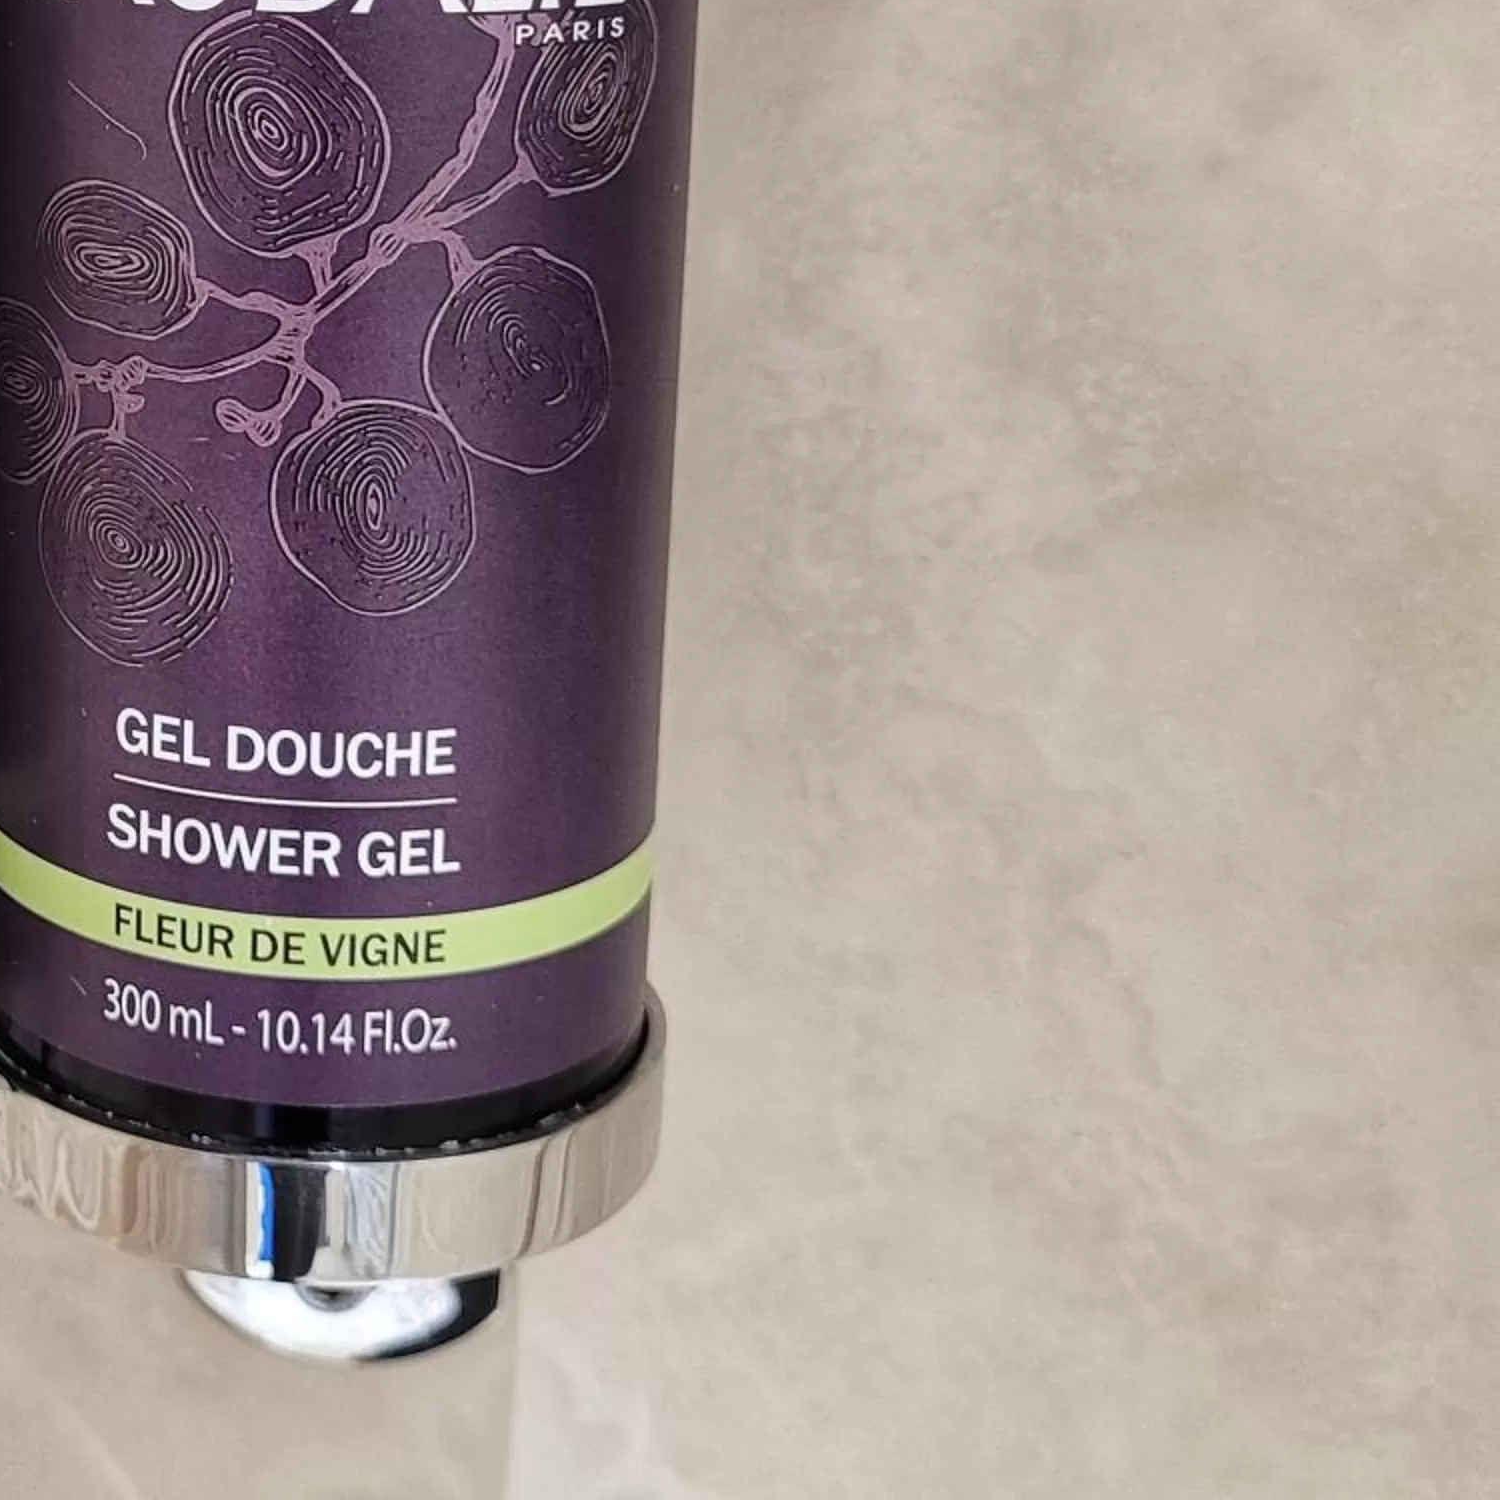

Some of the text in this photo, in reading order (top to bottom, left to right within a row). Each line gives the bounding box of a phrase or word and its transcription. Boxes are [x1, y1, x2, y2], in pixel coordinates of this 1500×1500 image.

[515, 16, 625, 45] PARIS
[115, 707, 457, 777] GEL DOUCHE
[106, 803, 462, 878] SHOWER GEL
[114, 902, 447, 967] FLEUR DE VIGNE
[102, 977, 161, 1033] 300
[168, 1001, 225, 1046] mL
[256, 1009, 356, 1056] 10.14
